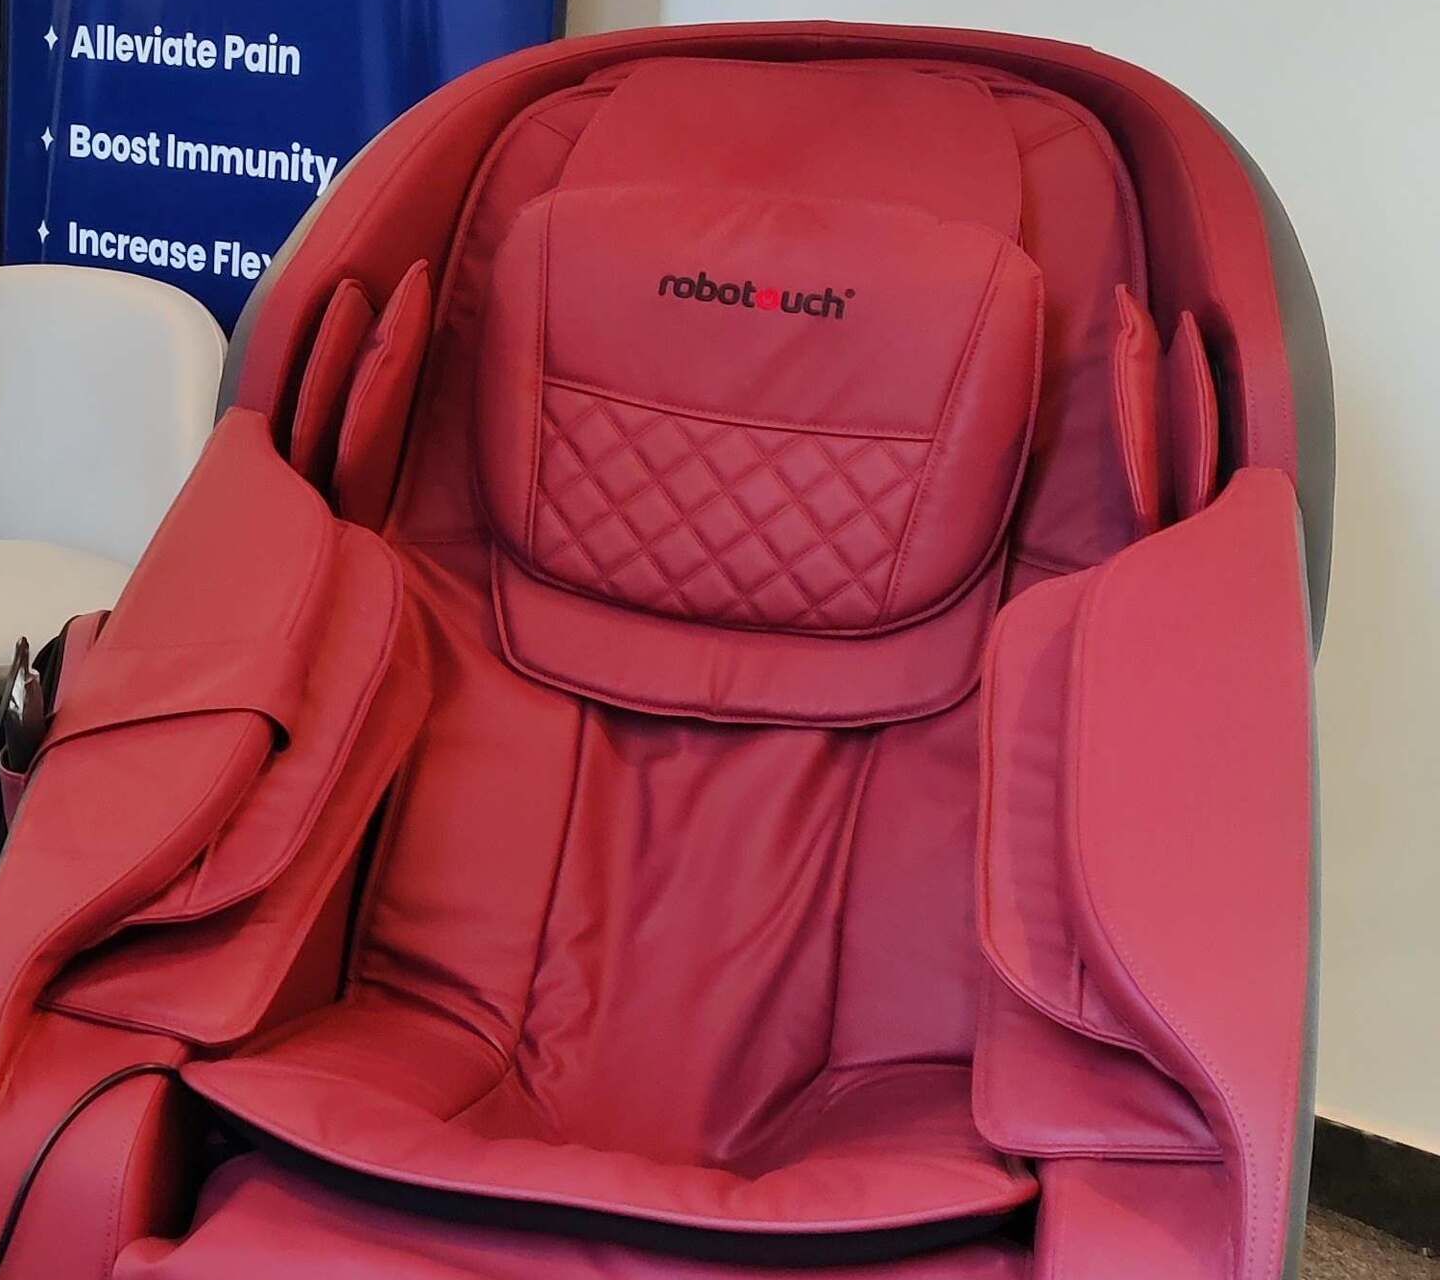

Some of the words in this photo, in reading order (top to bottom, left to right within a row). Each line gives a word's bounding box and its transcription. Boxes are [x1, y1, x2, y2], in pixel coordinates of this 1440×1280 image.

[70, 24, 217, 69] Alleviate
[224, 33, 301, 75] Pain
[69, 124, 161, 166] Boost
[166, 133, 338, 197] Immunity
[68, 221, 207, 272] Increase
